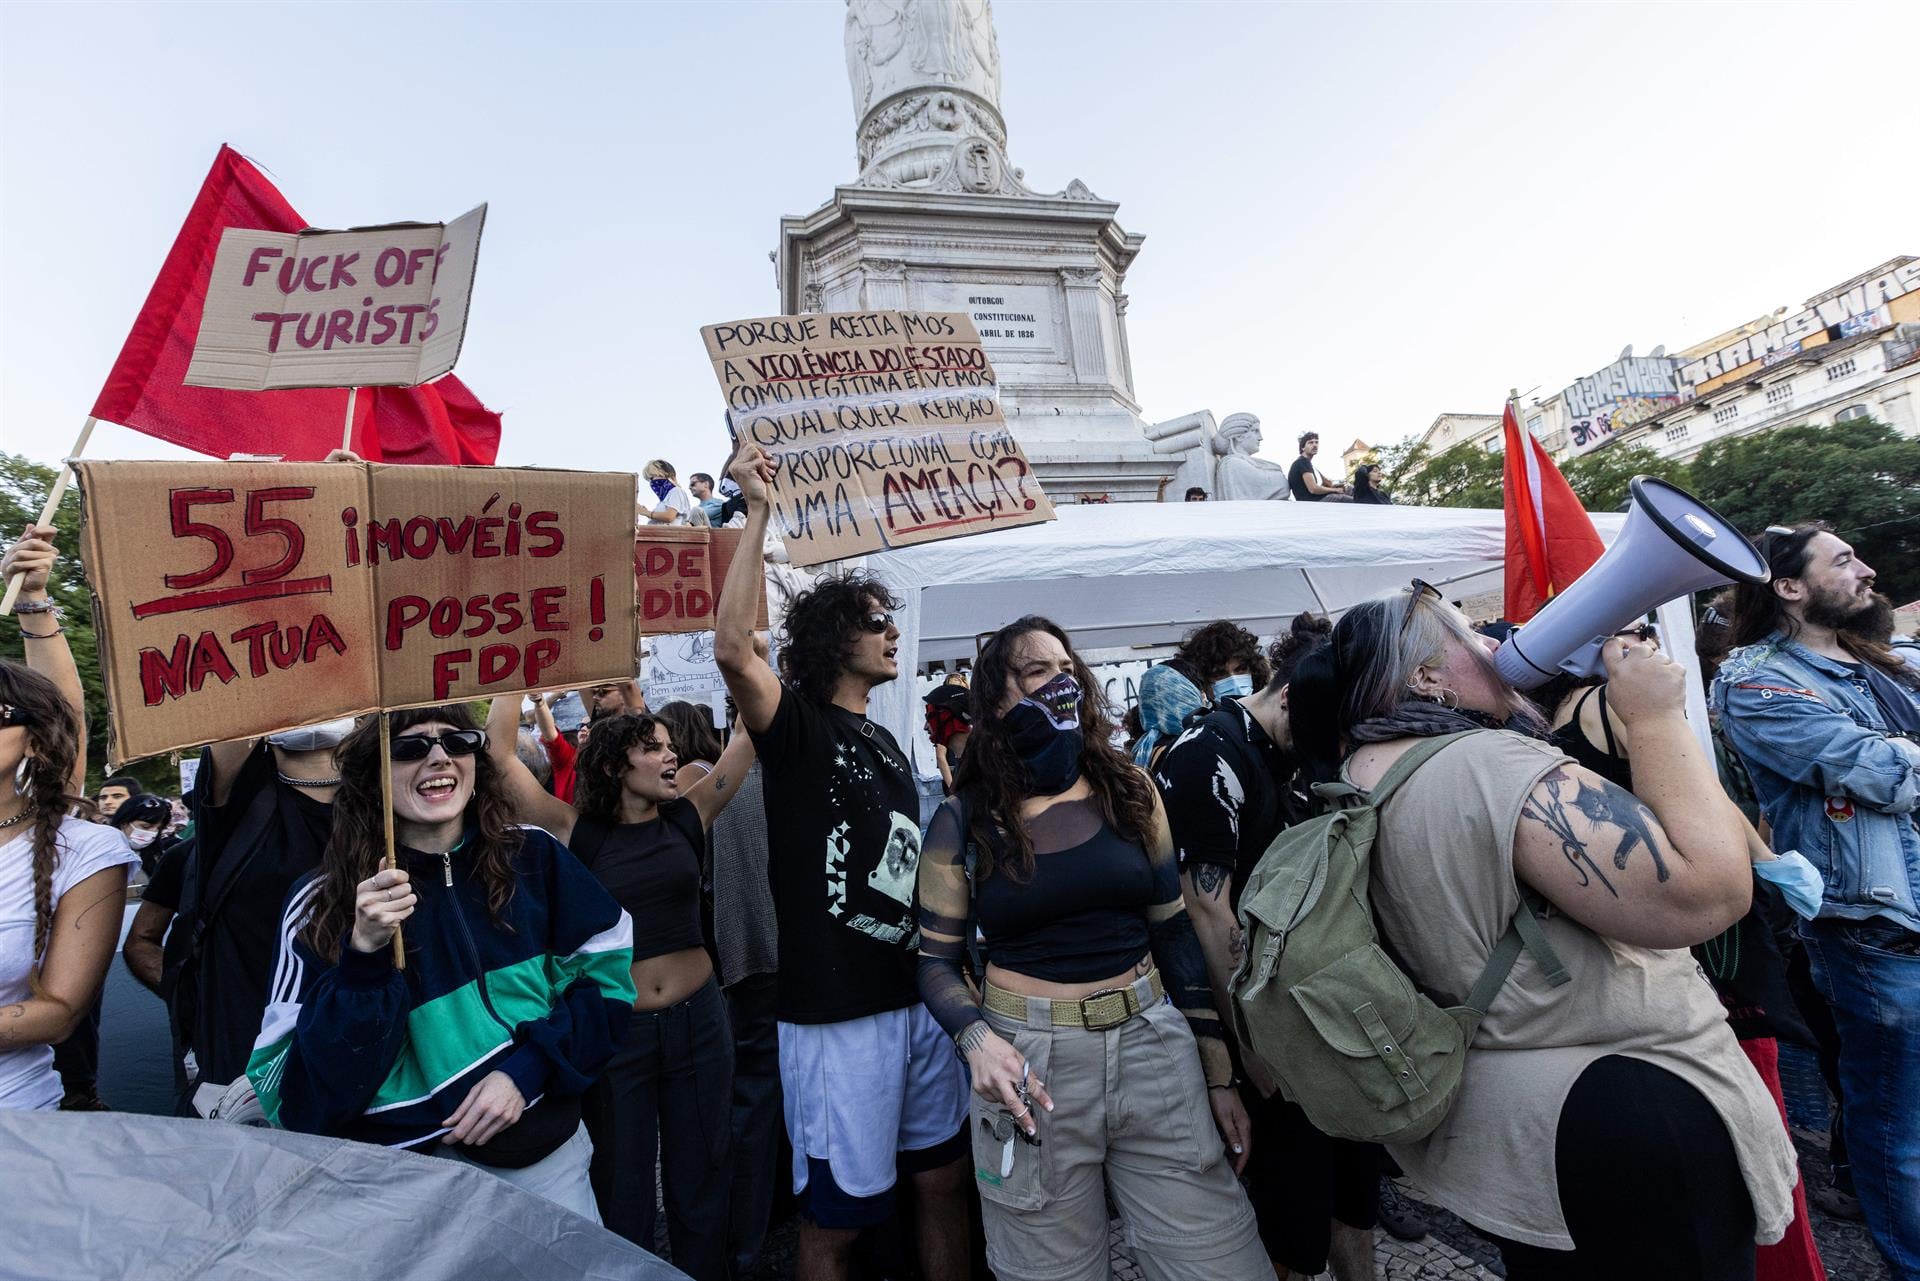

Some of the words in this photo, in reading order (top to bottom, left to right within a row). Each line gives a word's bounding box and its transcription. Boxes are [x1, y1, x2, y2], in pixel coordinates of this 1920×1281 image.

[242, 247, 360, 296] FUCK
[374, 242, 450, 288] OFF
[968, 296, 1004, 305] OUTORGOU
[974, 312, 1036, 322] CONSTITUCIONAL
[714, 318, 819, 352] PORQUE
[980, 329, 1002, 338] ABRIL
[1005, 330, 1015, 338] DE
[1018, 330, 1035, 338] 1826
[724, 360, 745, 383] A
[747, 346, 867, 381] VIOLÊNCIA
[870, 348, 901, 371] DO
[905, 346, 986, 371] ESTADO
[729, 382, 793, 412] COMO
[925, 370, 996, 388] VEMOS
[772, 432, 966, 491] PROPORCIONAL
[969, 430, 1018, 460] COMO
[775, 482, 861, 540] UMA
[883, 457, 1037, 530] AMEAÇA?
[164, 486, 317, 589] 55
[644, 580, 722, 620] DiD
[433, 638, 561, 700] FDP
[651, 686, 669, 696] bem
[672, 684, 694, 693] vindos
